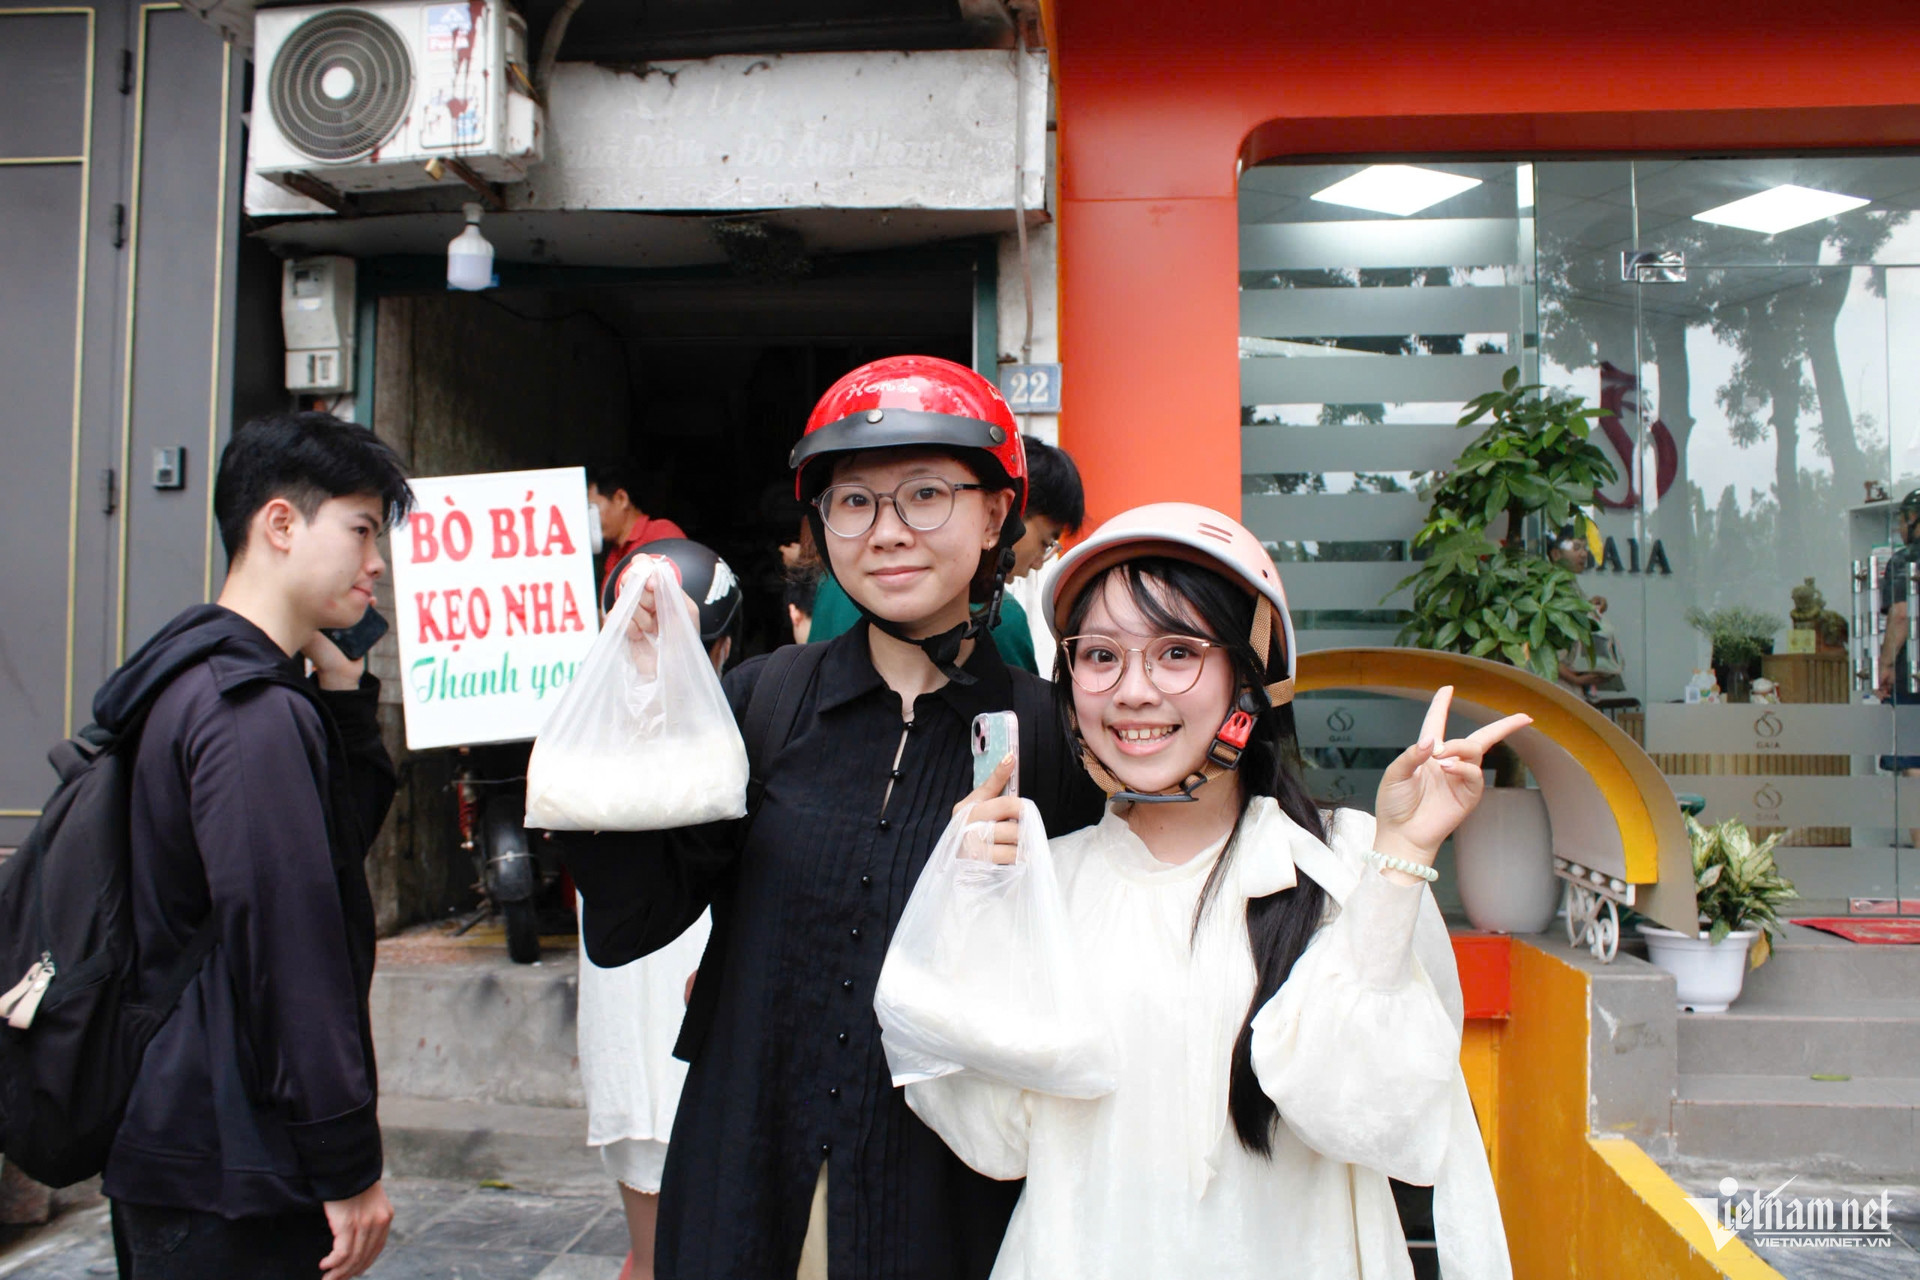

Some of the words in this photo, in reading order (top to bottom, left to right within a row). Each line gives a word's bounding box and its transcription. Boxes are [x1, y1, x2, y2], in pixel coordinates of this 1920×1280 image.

[1010, 371, 1049, 404] 22
[409, 496, 473, 563] BÒ
[489, 490, 576, 559] BÍA
[1585, 535, 1674, 575] AIA
[414, 587, 491, 652] KẸO
[502, 580, 585, 636] NHA
[410, 651, 518, 703] Thanh
